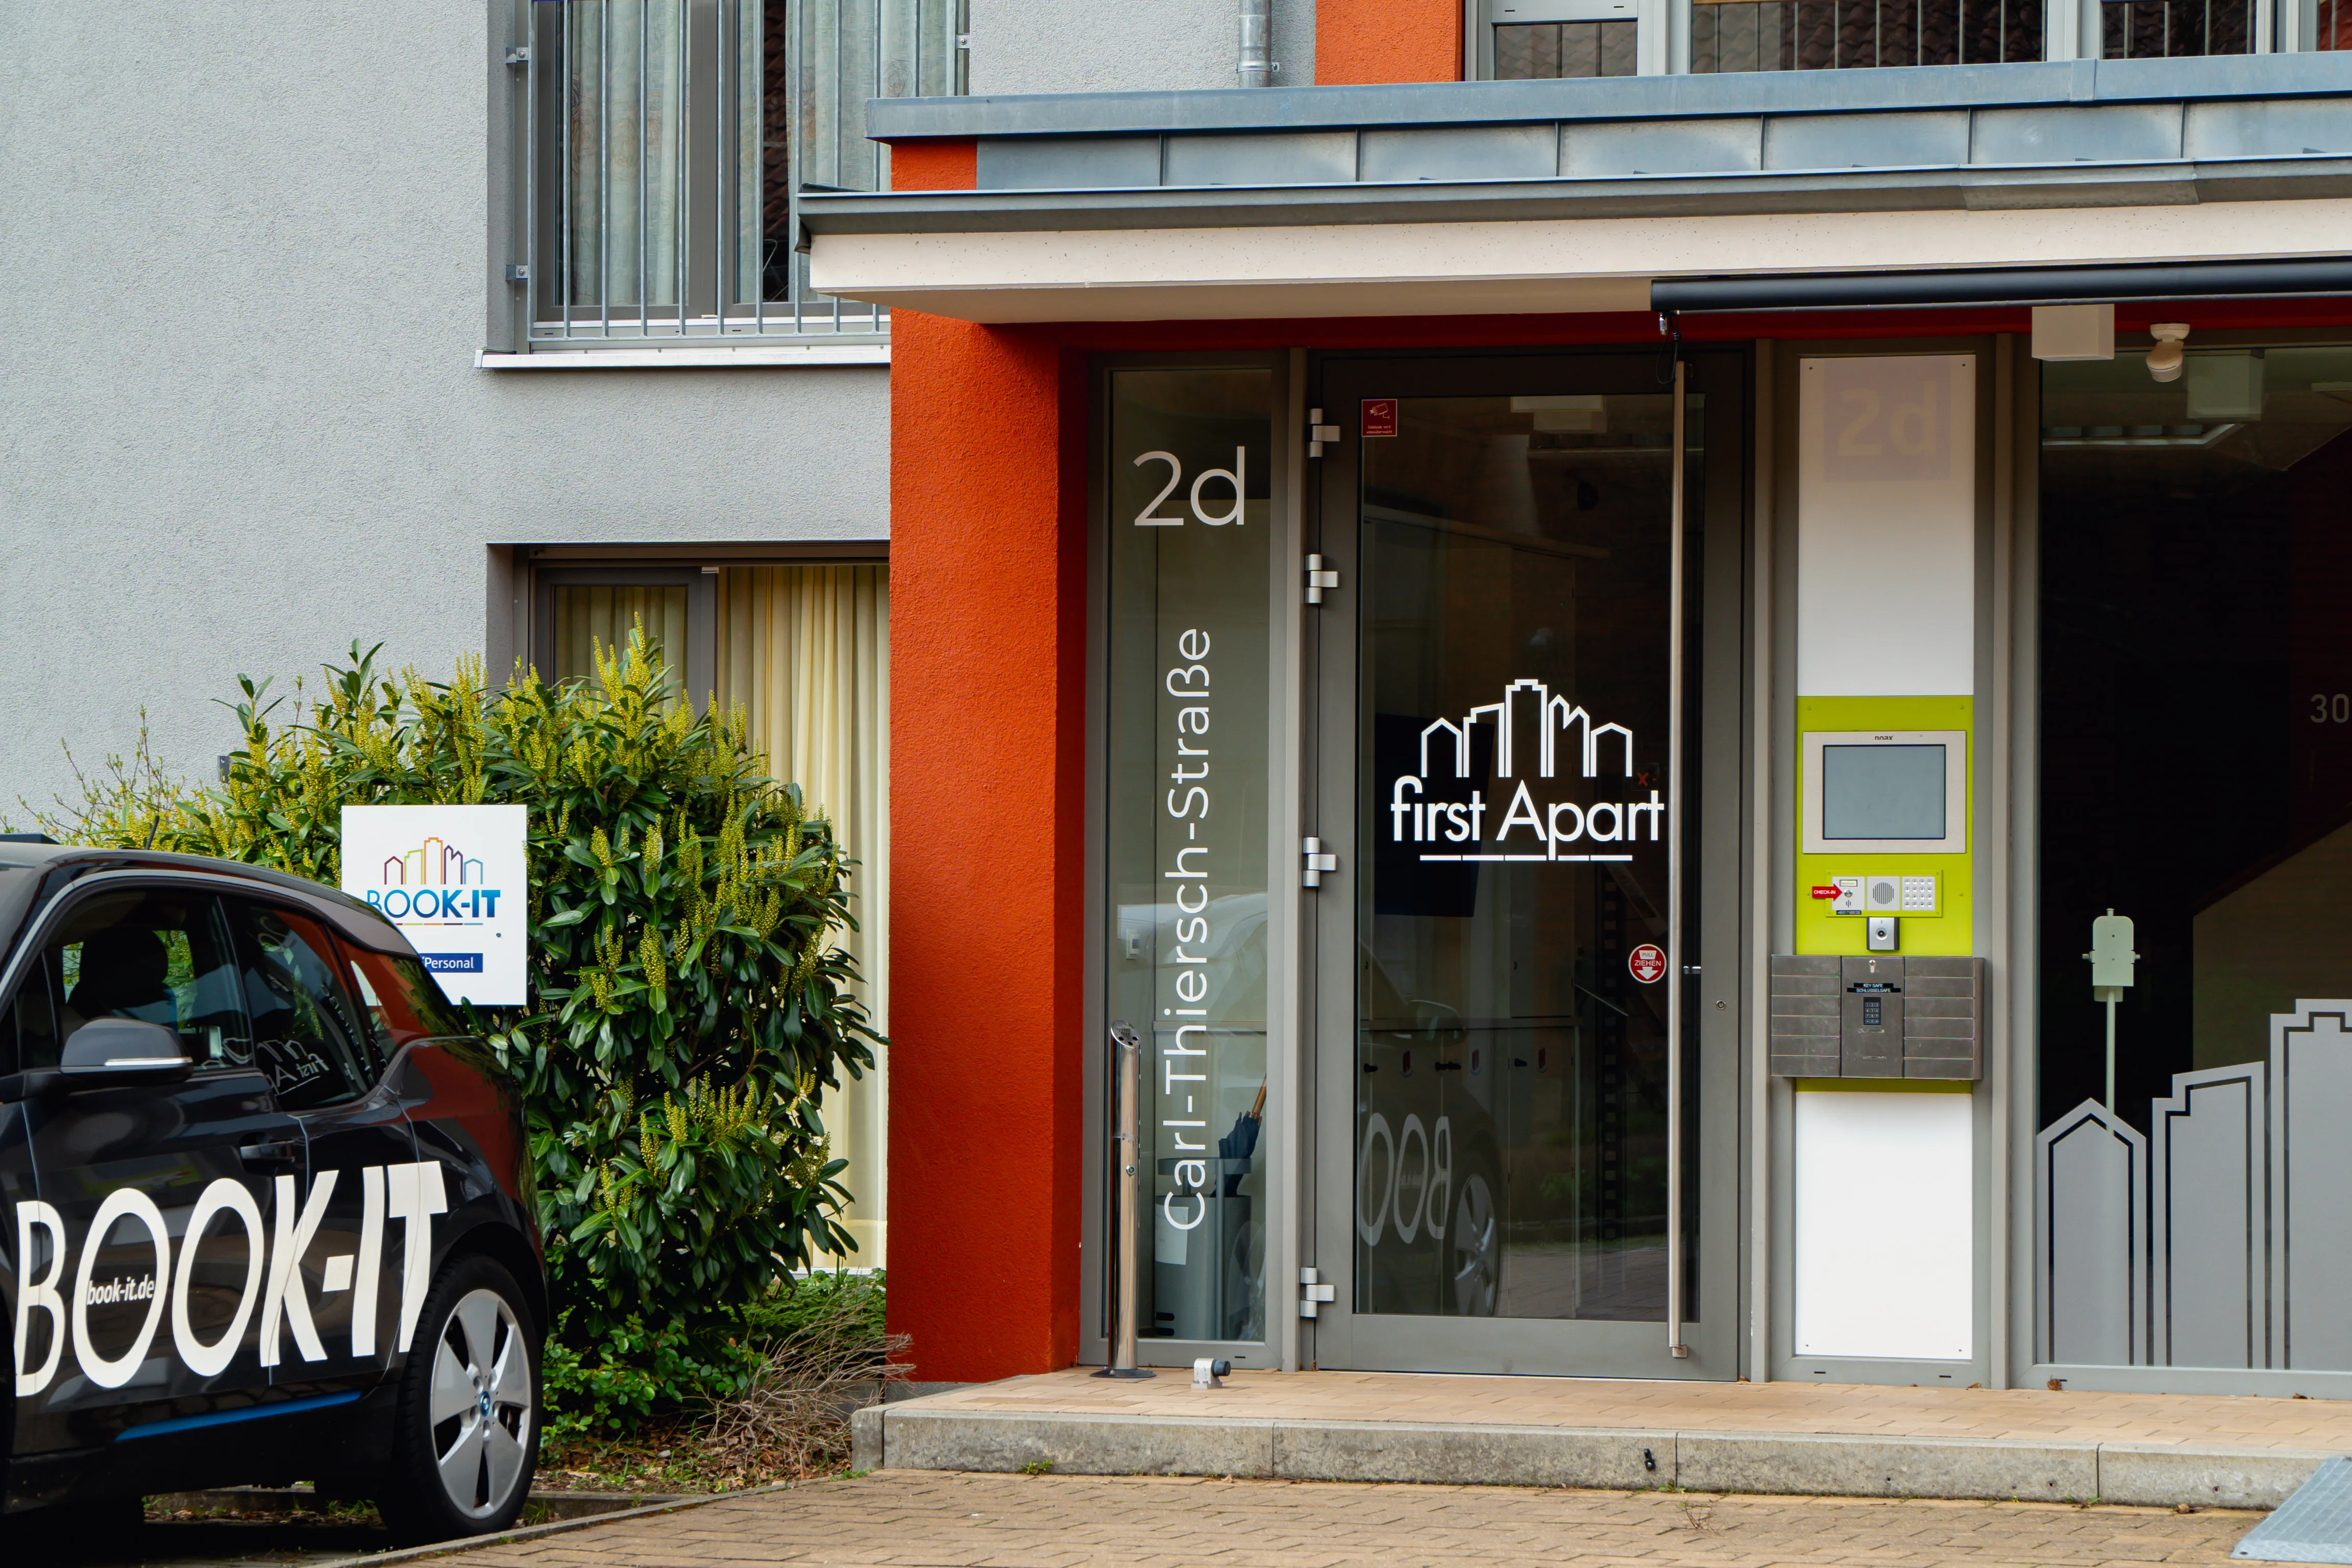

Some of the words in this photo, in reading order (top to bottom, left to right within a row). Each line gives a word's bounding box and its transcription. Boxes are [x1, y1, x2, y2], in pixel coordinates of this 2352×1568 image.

[1133, 446, 1245, 526] 2d
[2310, 694, 2349, 723] 30
[1391, 776, 1486, 841] first
[1496, 779, 1664, 861] Apart
[365, 889, 501, 918] BOOK-IT
[1163, 628, 1210, 1230] Carl-Thiersch-Straße
[14, 1161, 448, 1397] BOOK-IT
[86, 1273, 155, 1306] book-it.de
